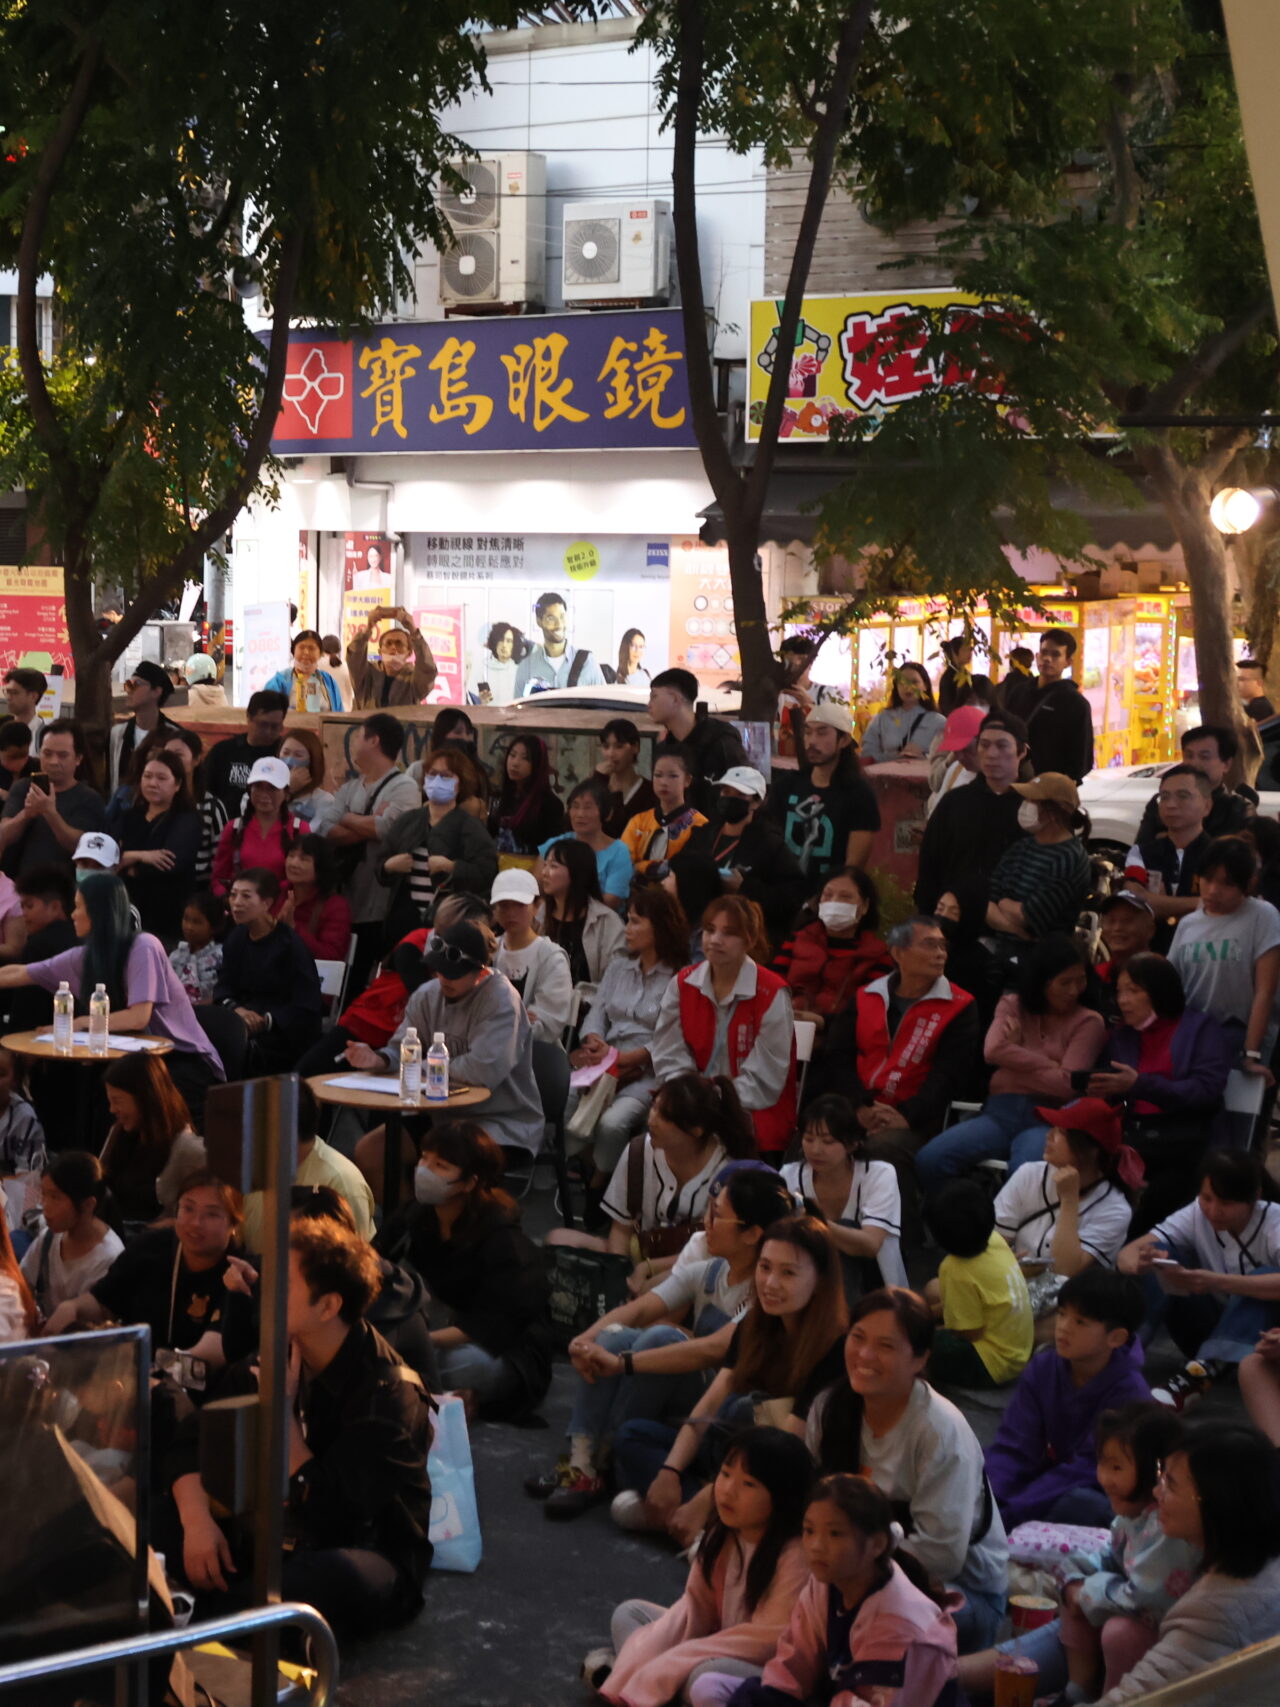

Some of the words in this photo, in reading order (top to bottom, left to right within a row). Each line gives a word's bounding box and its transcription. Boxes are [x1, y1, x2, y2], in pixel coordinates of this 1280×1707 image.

[359, 326, 687, 439] 寶島眼鏡
[426, 536, 473, 551] 移動視線
[477, 536, 525, 551] 對焦清晰
[426, 554, 525, 569] 轉眼之間輕鬆應對
